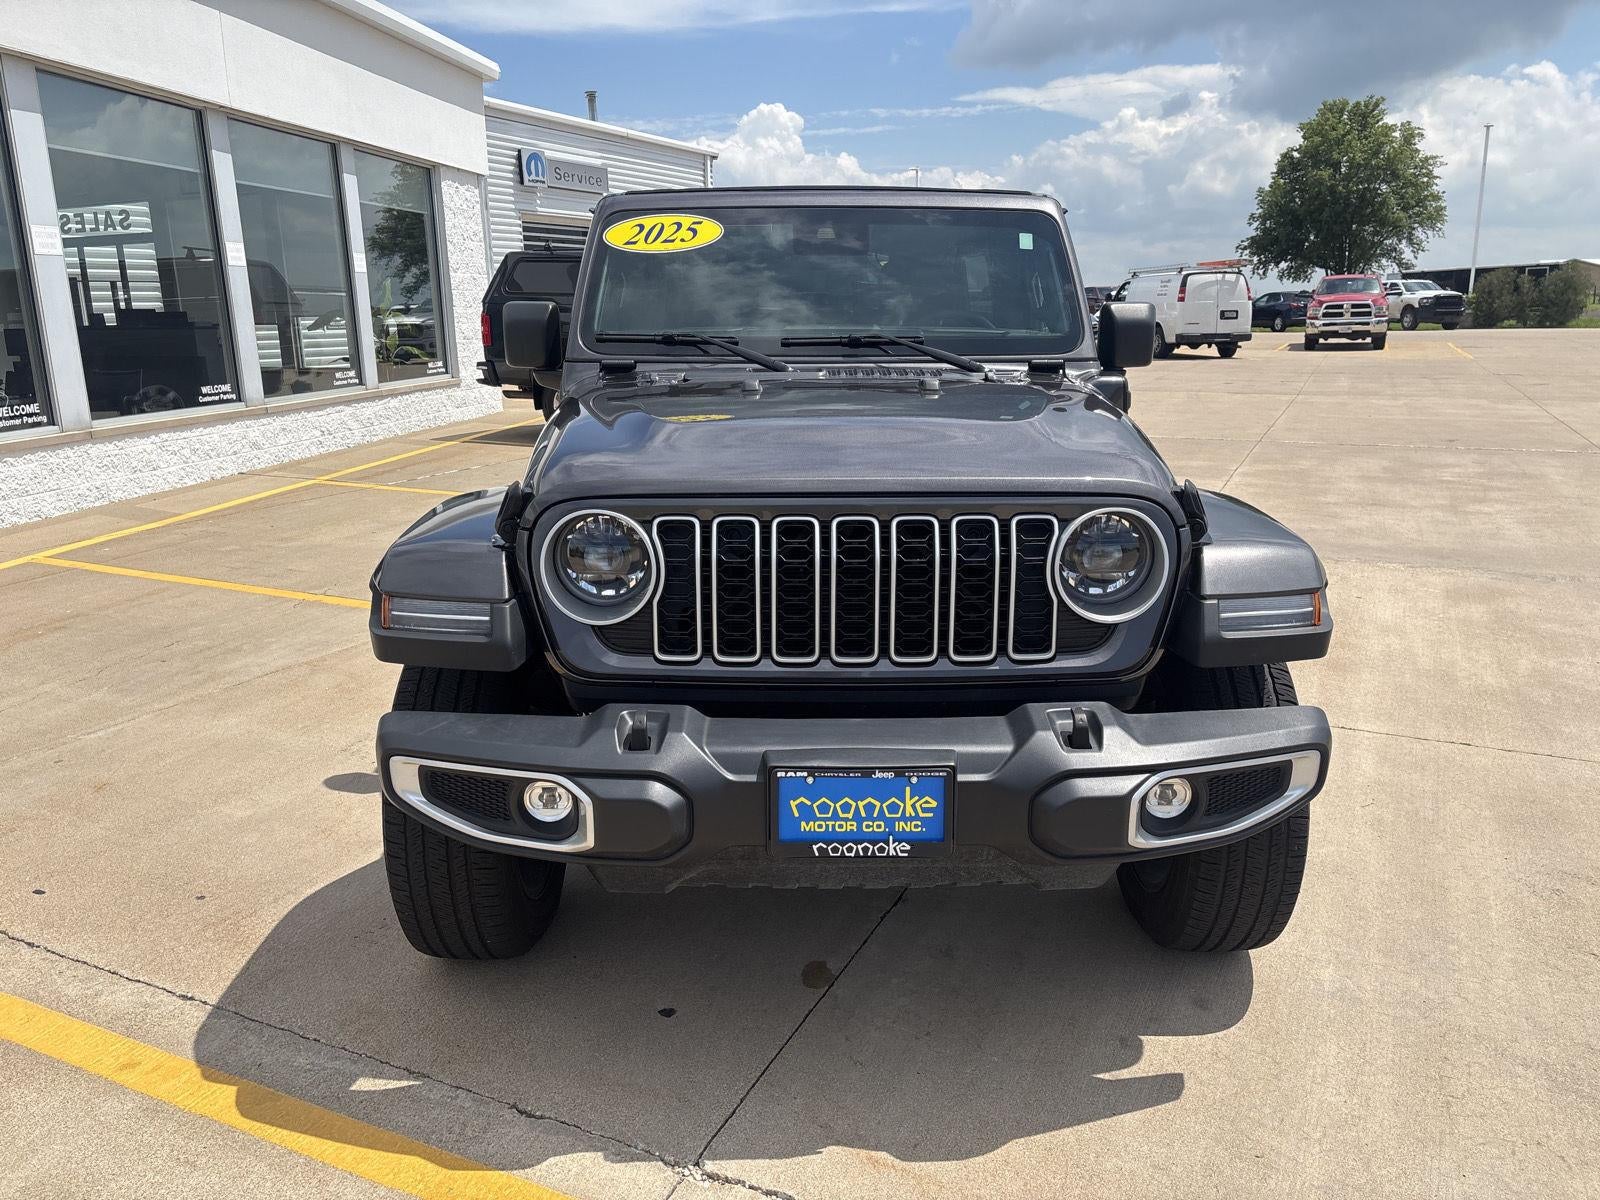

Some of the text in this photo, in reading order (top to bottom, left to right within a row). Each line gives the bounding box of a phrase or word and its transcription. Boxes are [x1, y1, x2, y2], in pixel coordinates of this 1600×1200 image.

[554, 166, 602, 186] Service
[622, 221, 703, 246] 2025
[200, 383, 232, 394] WELCOME
[198, 395, 220, 403] Customer
[0, 403, 40, 417] ELCOME
[22, 414, 47, 424] Parking
[872, 769, 895, 779] Jeep
[789, 786, 938, 819] roanoke
[800, 820, 926, 832] MOTOR CO. INC.
[812, 834, 911, 857] roanoke
